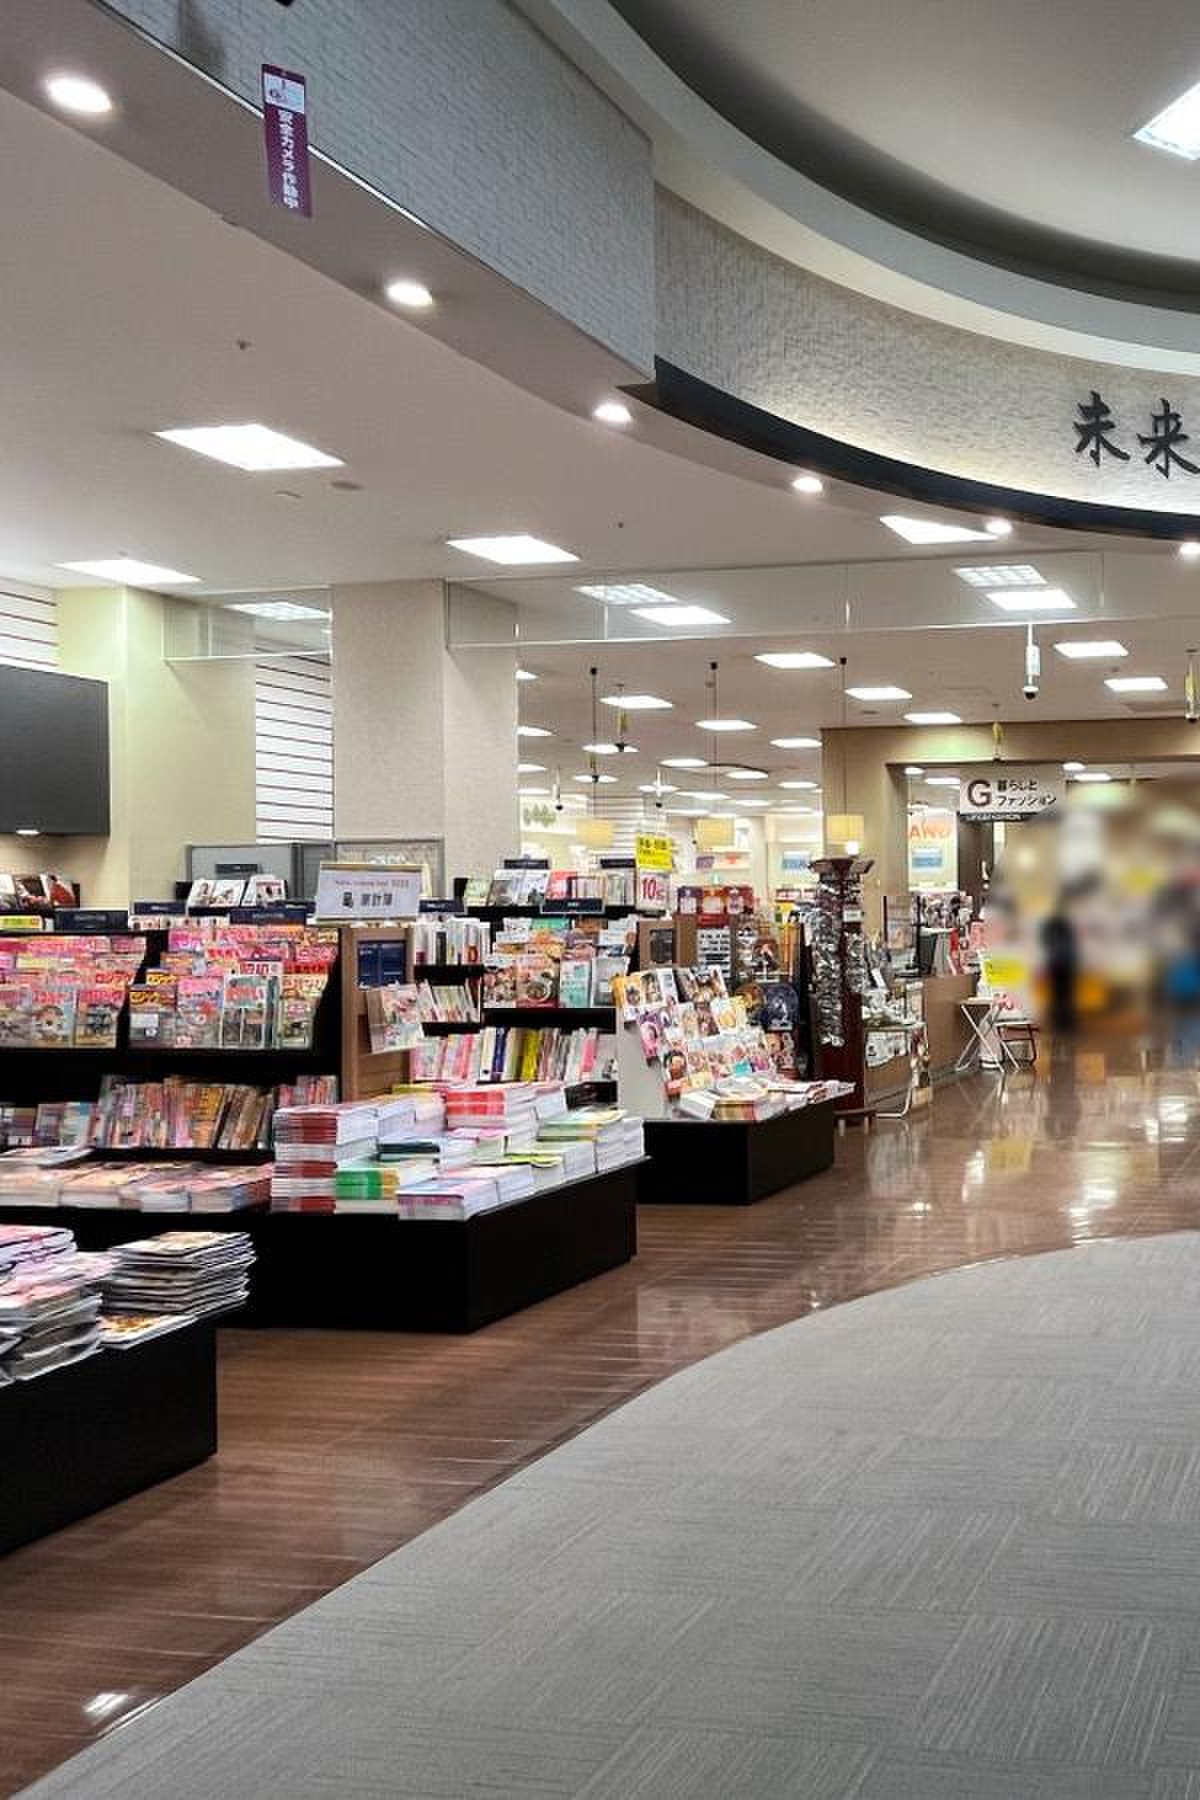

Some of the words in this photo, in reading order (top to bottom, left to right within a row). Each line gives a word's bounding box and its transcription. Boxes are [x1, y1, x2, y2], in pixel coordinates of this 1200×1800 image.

[968, 780, 992, 807] G
[998, 795, 1057, 806] ファッション
